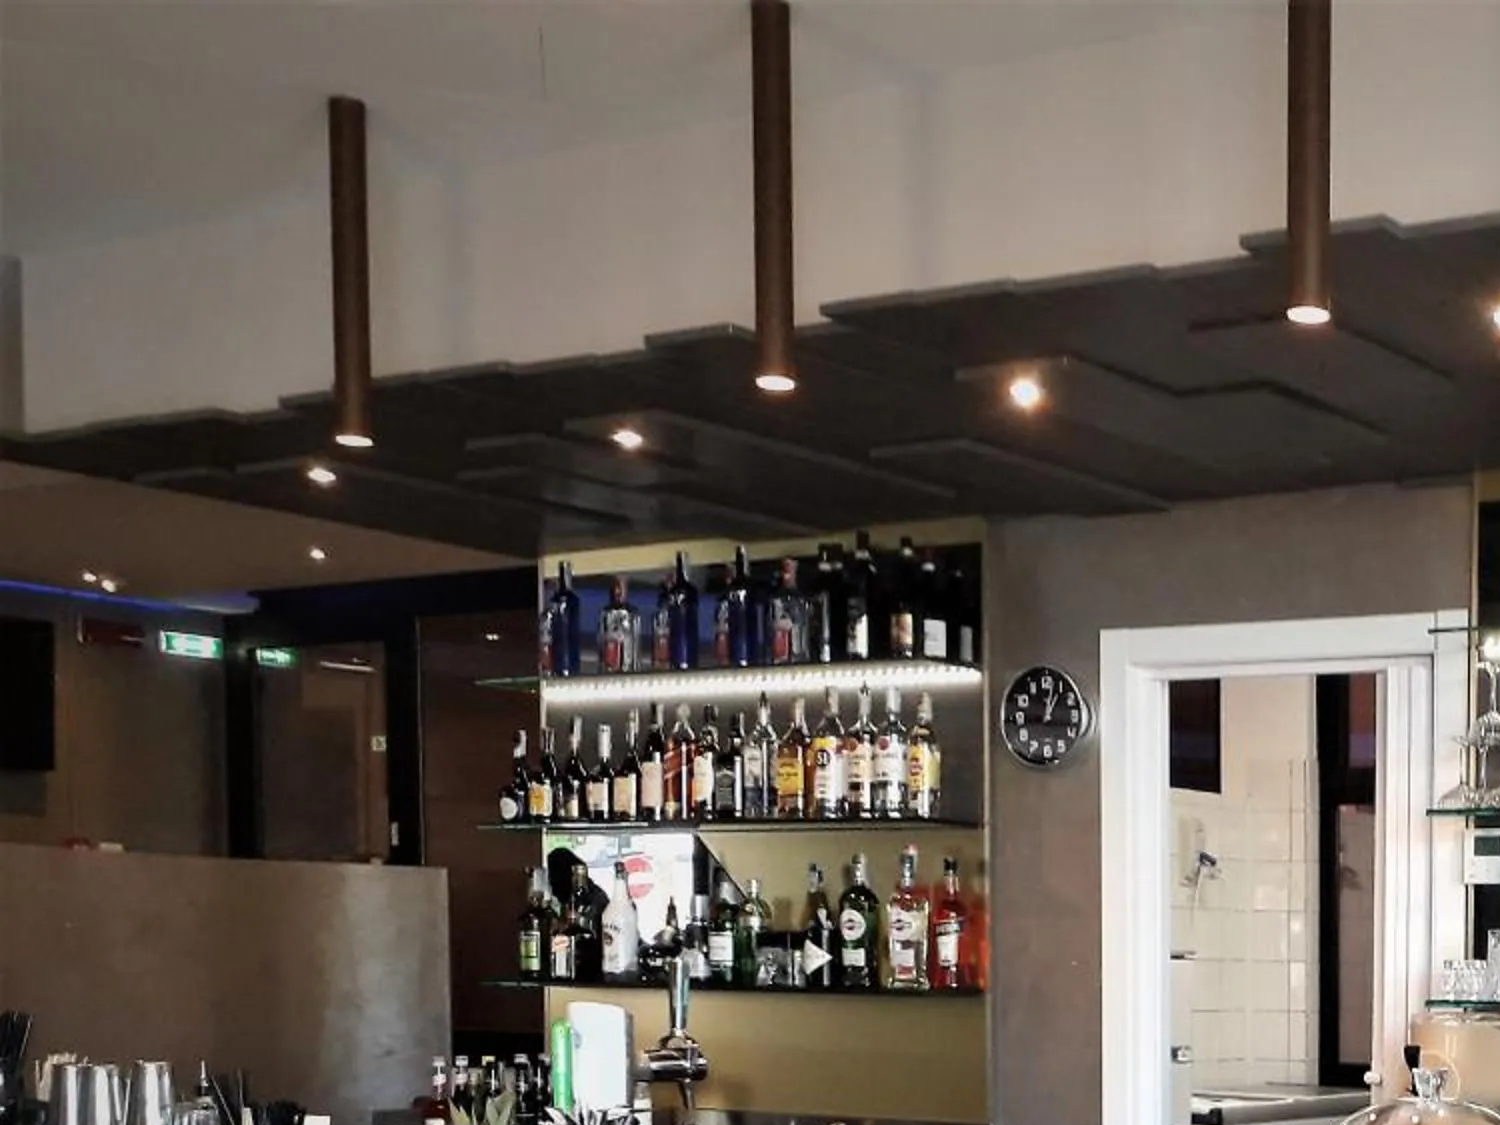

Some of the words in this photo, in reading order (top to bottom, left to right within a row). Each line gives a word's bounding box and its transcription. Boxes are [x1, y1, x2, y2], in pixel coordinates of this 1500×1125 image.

[1041, 676, 1053, 689] 12
[1016, 694, 1029, 707] 10
[1067, 692, 1075, 706] 2
[1015, 711, 1025, 725] 9
[1070, 709, 1079, 723] 3
[1019, 728, 1029, 742] 8
[1067, 726, 1077, 738] 4
[1029, 740, 1039, 753] 7
[1043, 745, 1053, 758] 6
[1057, 739, 1066, 753] 5
